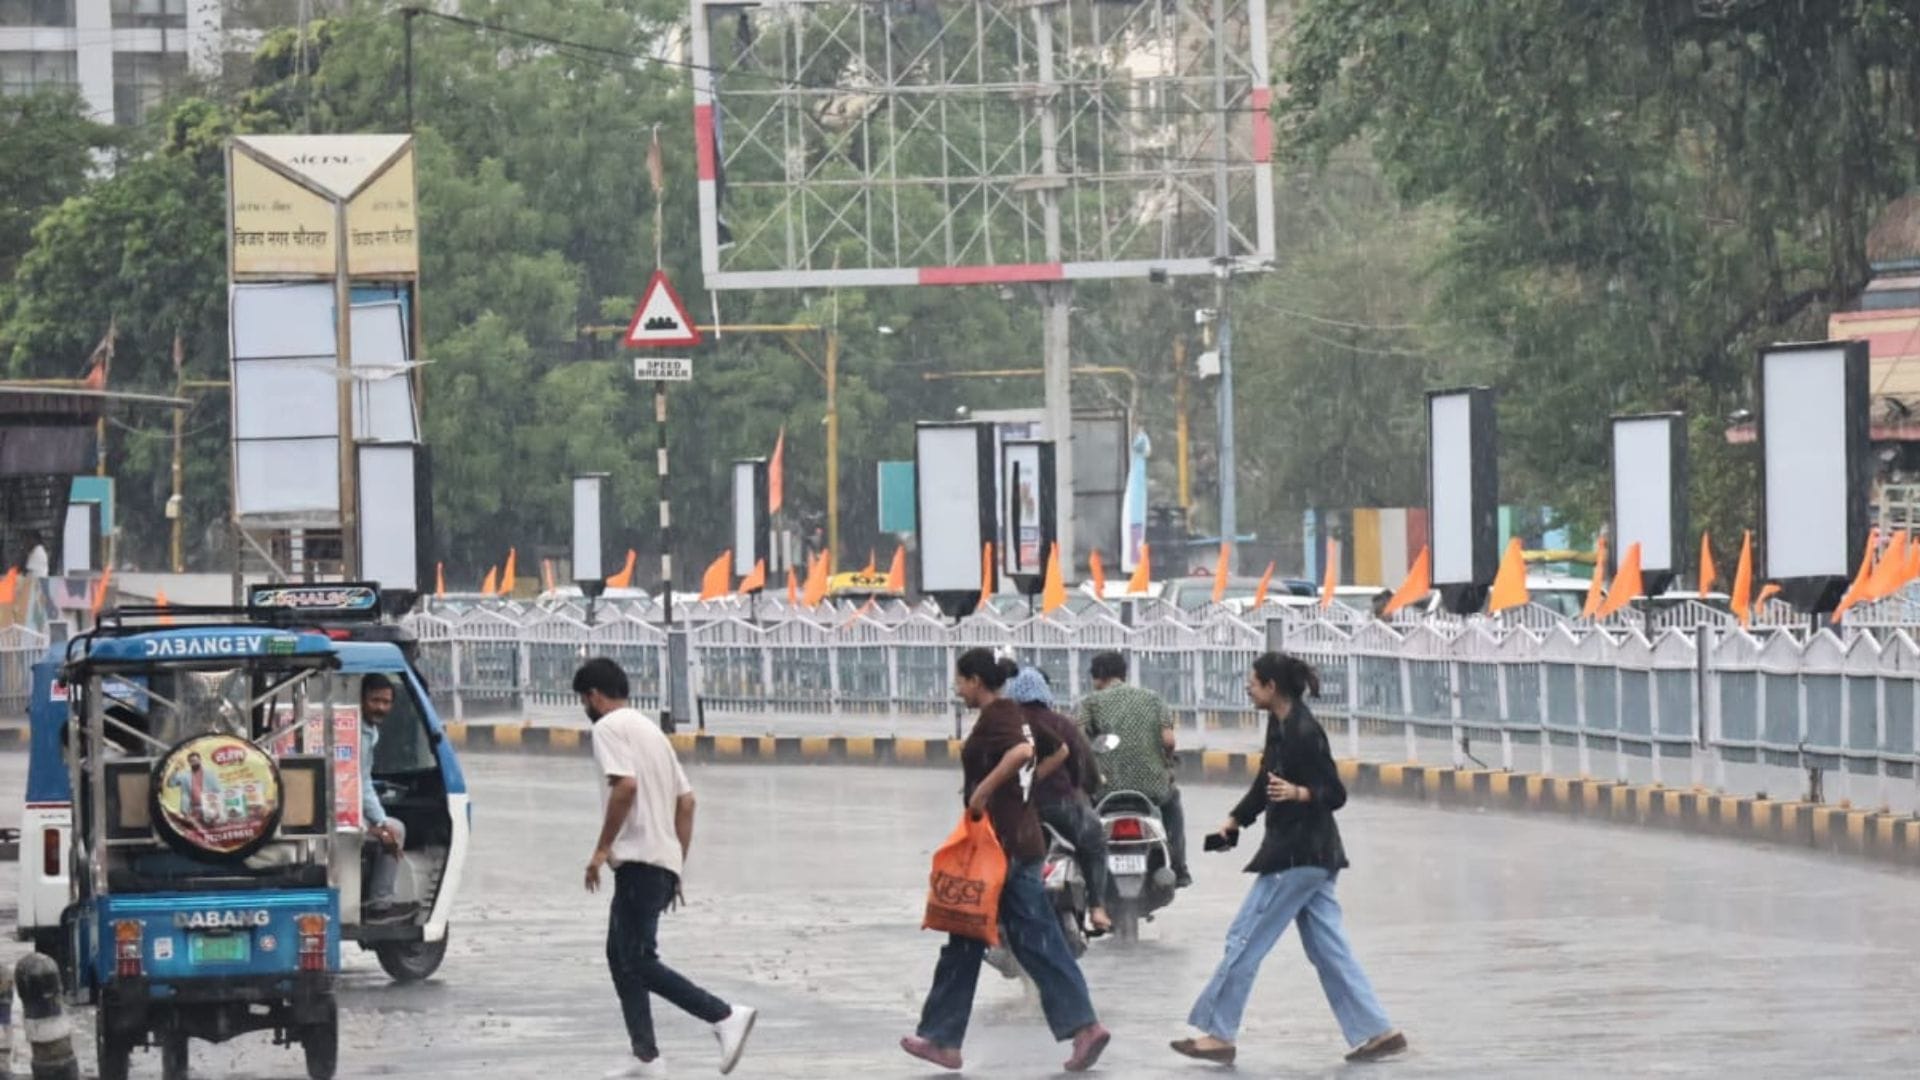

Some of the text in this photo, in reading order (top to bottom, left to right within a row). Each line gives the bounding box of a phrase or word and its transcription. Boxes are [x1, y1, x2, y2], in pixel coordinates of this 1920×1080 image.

[647, 361, 682, 369] SPEED
[638, 369, 689, 377] BREAKER
[173, 909, 270, 928] DABANG
